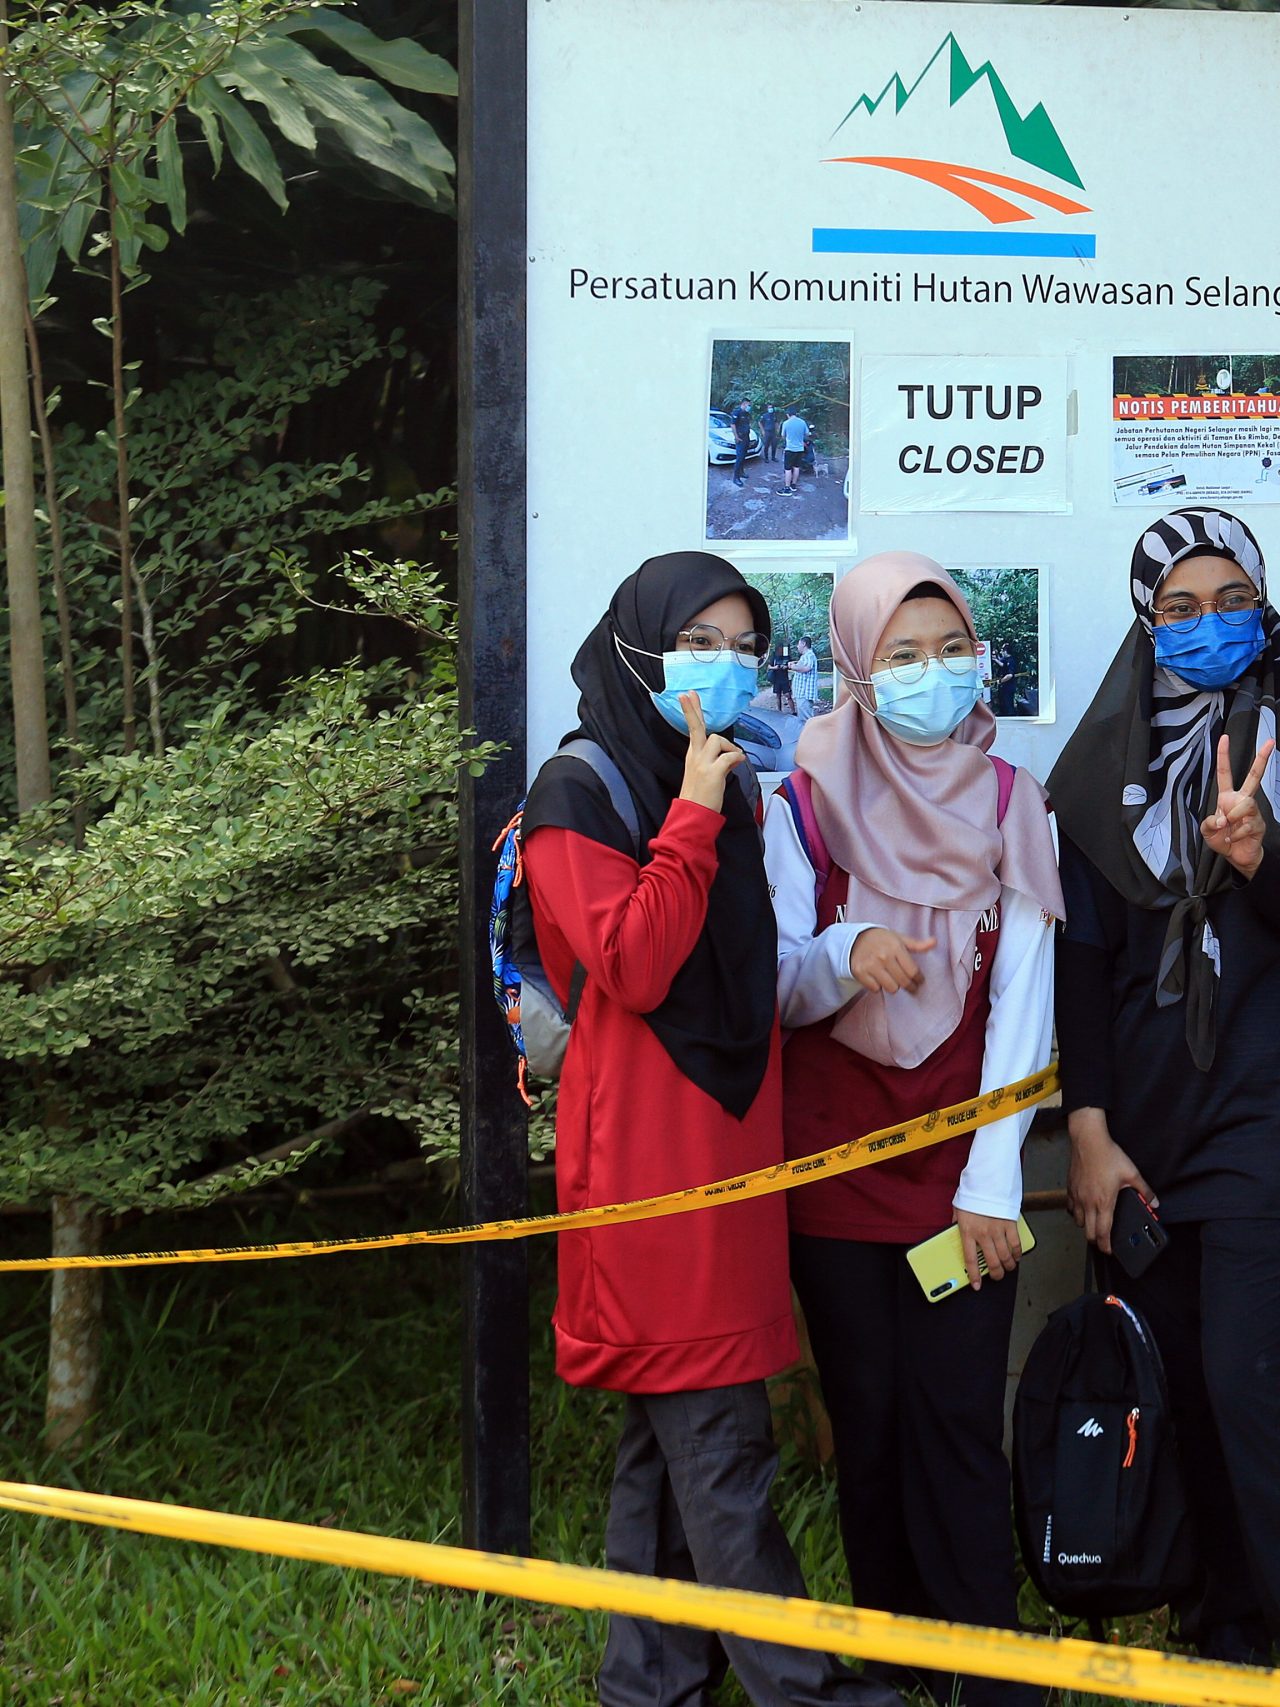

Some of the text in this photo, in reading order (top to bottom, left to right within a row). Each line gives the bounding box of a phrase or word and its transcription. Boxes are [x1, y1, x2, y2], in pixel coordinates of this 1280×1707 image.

[570, 268, 736, 300] Persatuan
[750, 270, 901, 302] Komuniti
[913, 272, 1012, 303] Hutan
[1021, 274, 1174, 306] Wawasan
[898, 385, 1042, 420] TUTUP
[1119, 400, 1165, 415] NOTIS
[898, 445, 1044, 474] CLOSED
[1058, 1552, 1102, 1566] Quechua
